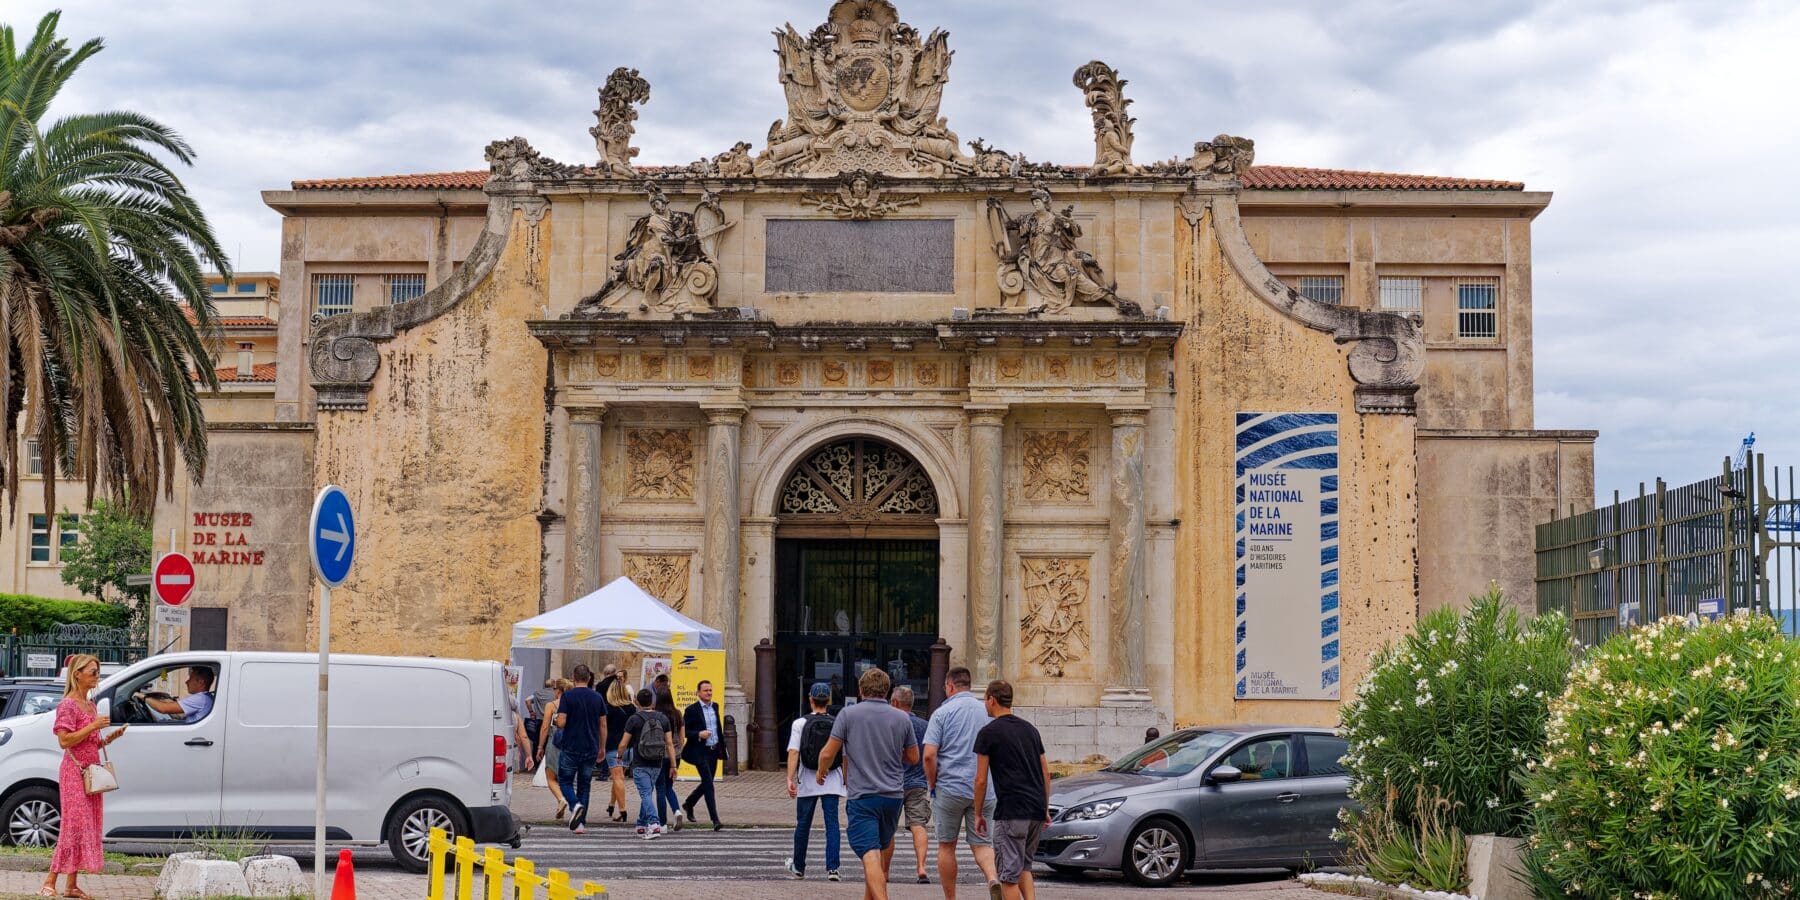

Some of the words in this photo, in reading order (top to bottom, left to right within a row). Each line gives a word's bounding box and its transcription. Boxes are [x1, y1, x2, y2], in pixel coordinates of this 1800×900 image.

[1250, 471, 1287, 486] MUSÉE
[1250, 490, 1304, 503] NATIONAL
[193, 511, 253, 527] MUSEE
[1250, 506, 1263, 519] DE
[1267, 506, 1281, 519] LA
[1250, 523, 1293, 536] MARINE
[193, 532, 216, 546] DE
[225, 532, 248, 546] LA
[1250, 544, 1261, 552] 400
[1262, 544, 1274, 552] ANS
[192, 551, 265, 566] MARINE
[1250, 562, 1283, 570] MARITIMES
[1250, 670, 1275, 679] MUSÉE
[1251, 679, 1283, 687] NATIONAL
[1271, 687, 1298, 695] MARINE
